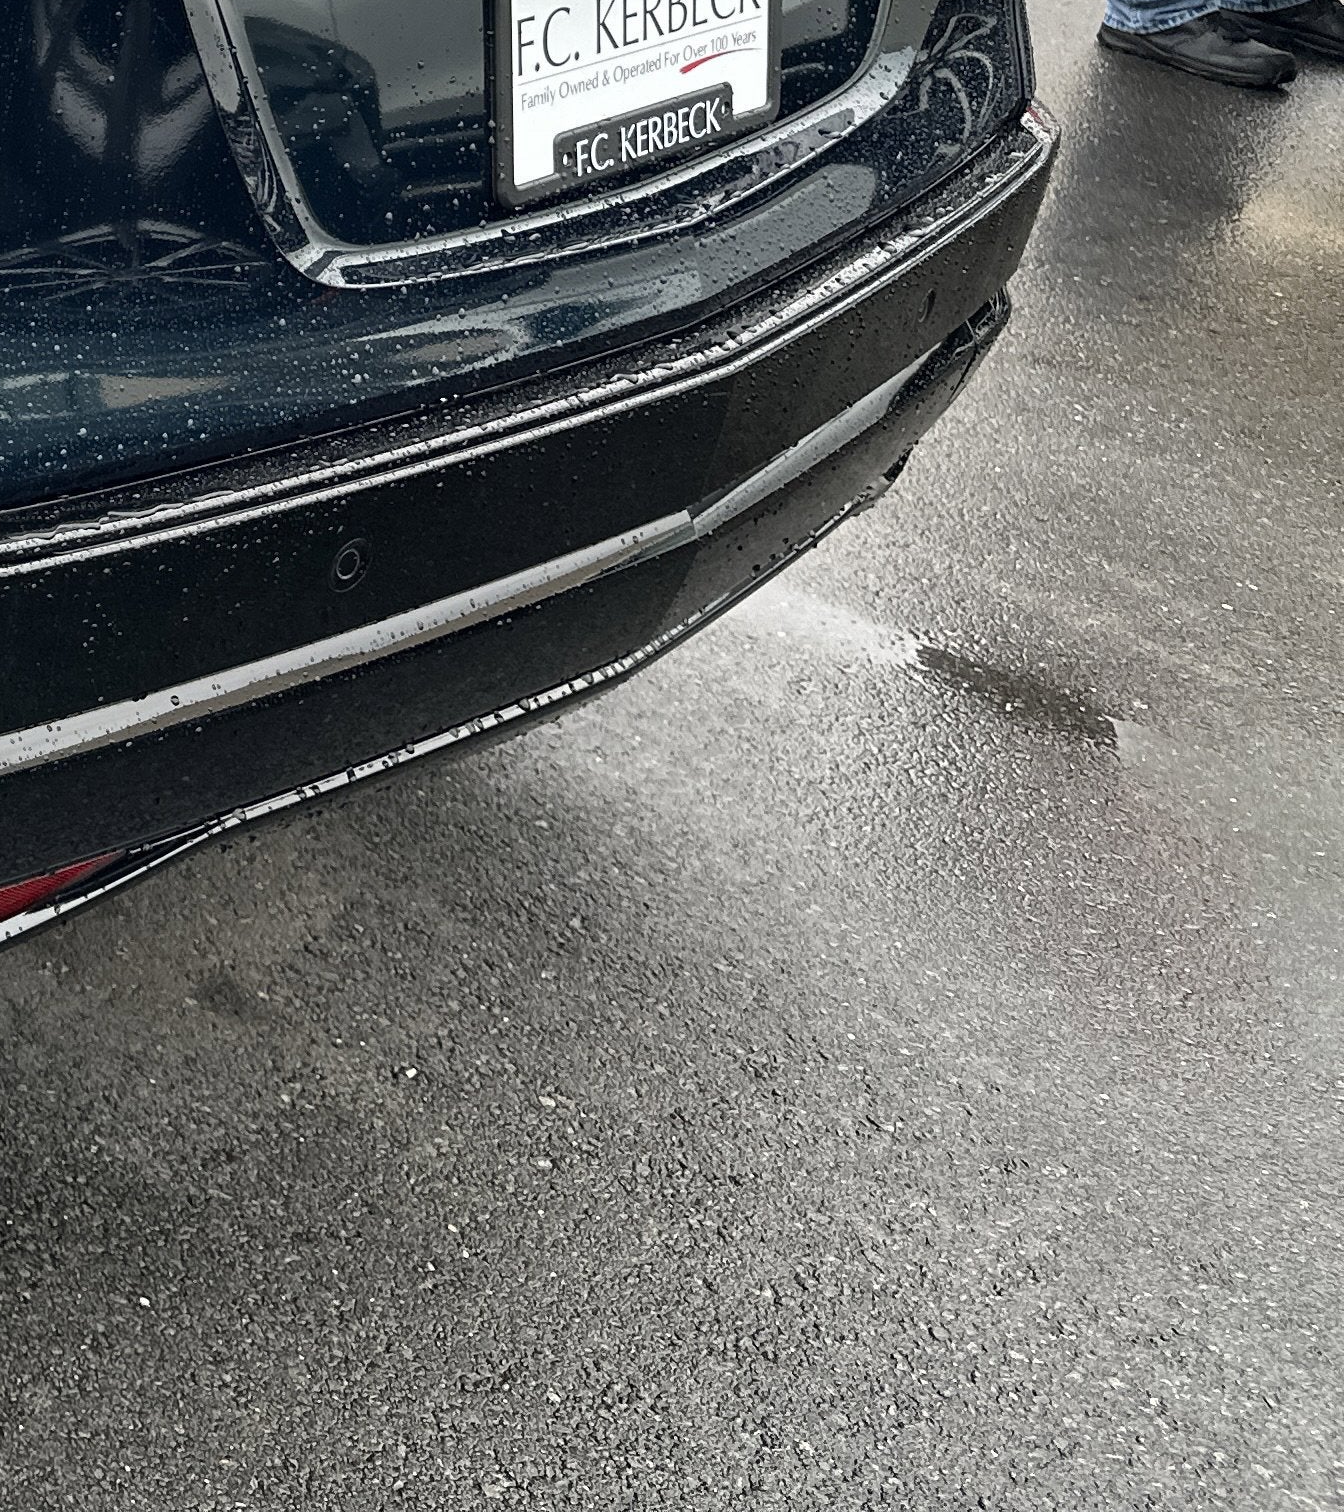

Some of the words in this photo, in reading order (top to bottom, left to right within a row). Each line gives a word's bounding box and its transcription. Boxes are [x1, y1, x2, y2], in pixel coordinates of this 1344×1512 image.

[516, 6, 580, 76] F.C.
[521, 87, 556, 111] Family
[559, 72, 599, 99] Owned
[602, 70, 611, 86] &
[613, 55, 662, 84] Operated
[664, 51, 681, 68] For
[683, 43, 708, 61] Over
[711, 35, 728, 52] 100
[731, 30, 757, 47] Years
[575, 133, 615, 177] F.C.
[620, 97, 721, 163] KERBECK
